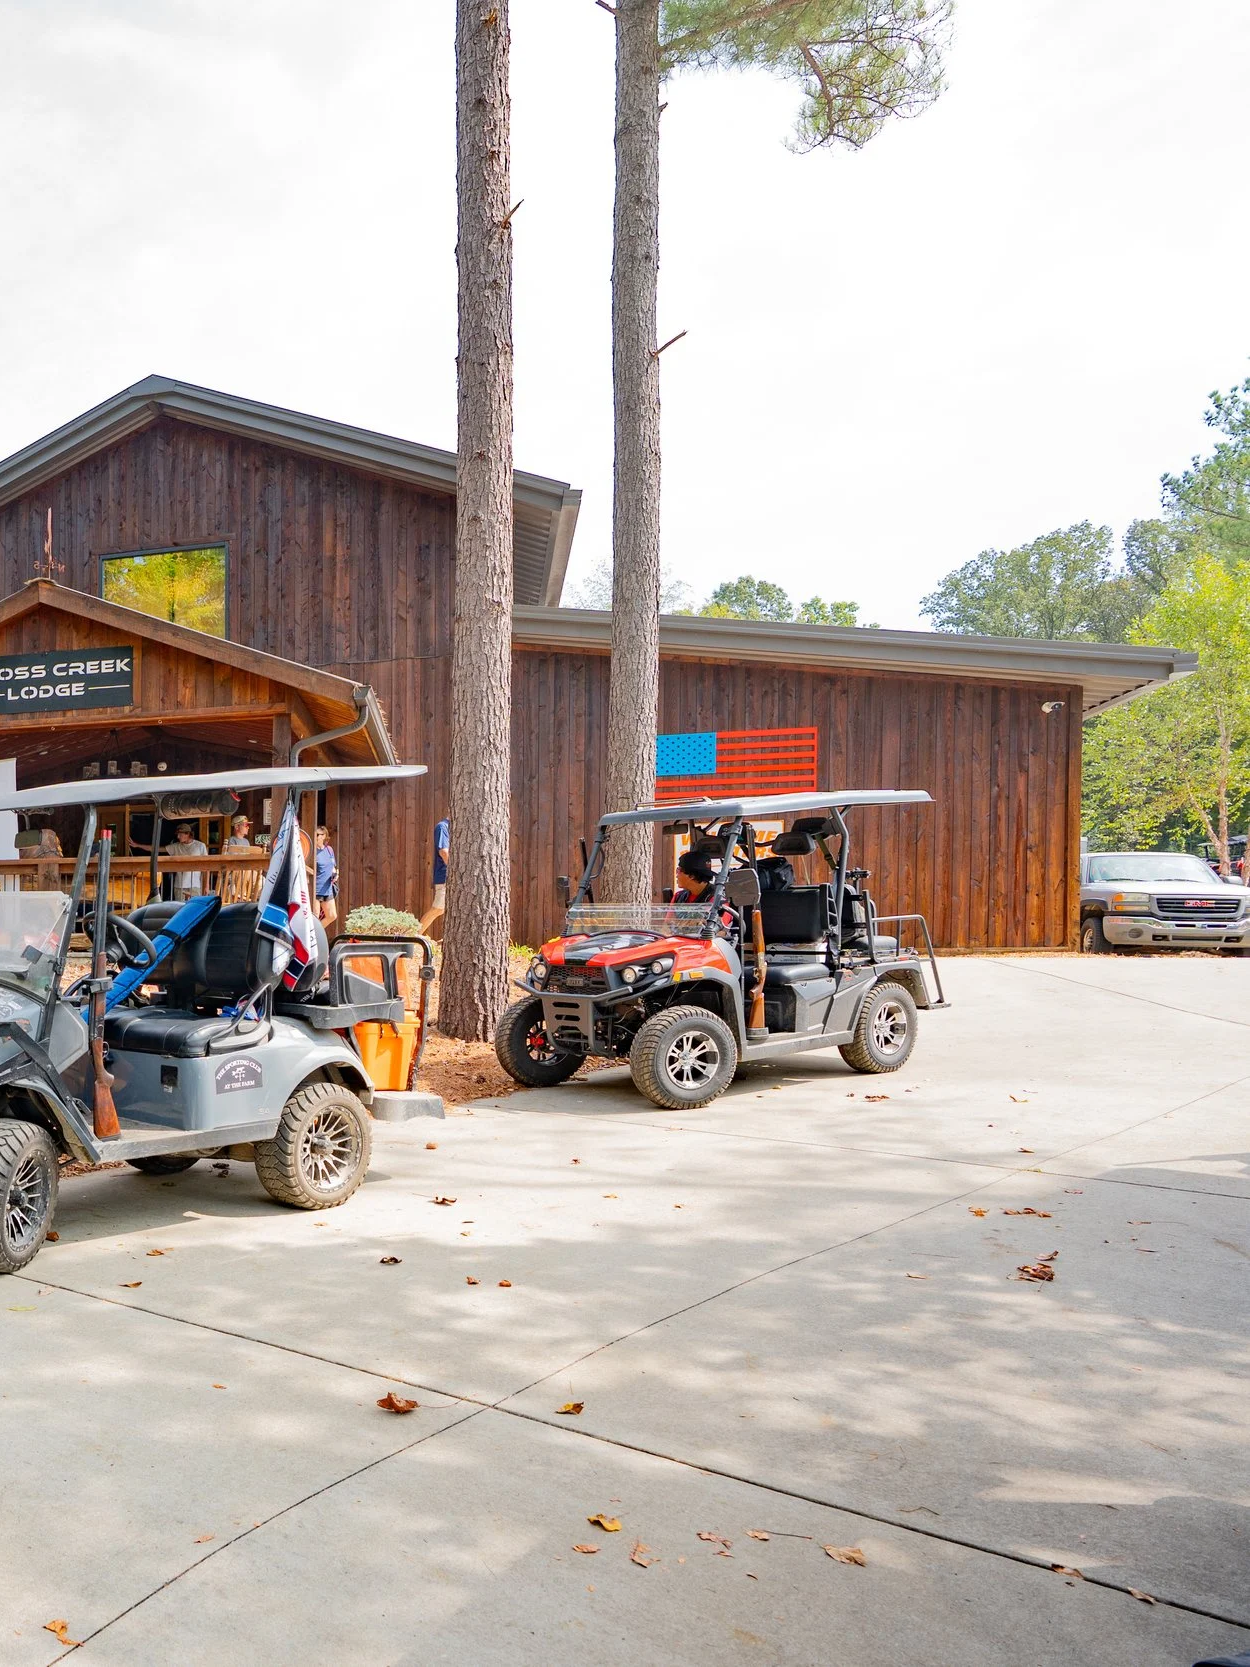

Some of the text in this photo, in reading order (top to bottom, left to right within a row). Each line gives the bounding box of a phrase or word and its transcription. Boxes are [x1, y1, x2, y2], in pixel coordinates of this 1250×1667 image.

[52, 658, 131, 677] CREEK
[7, 682, 86, 701] LODGE
[225, 1059, 250, 1071] SPORTING
[250, 1061, 261, 1073] CLUB
